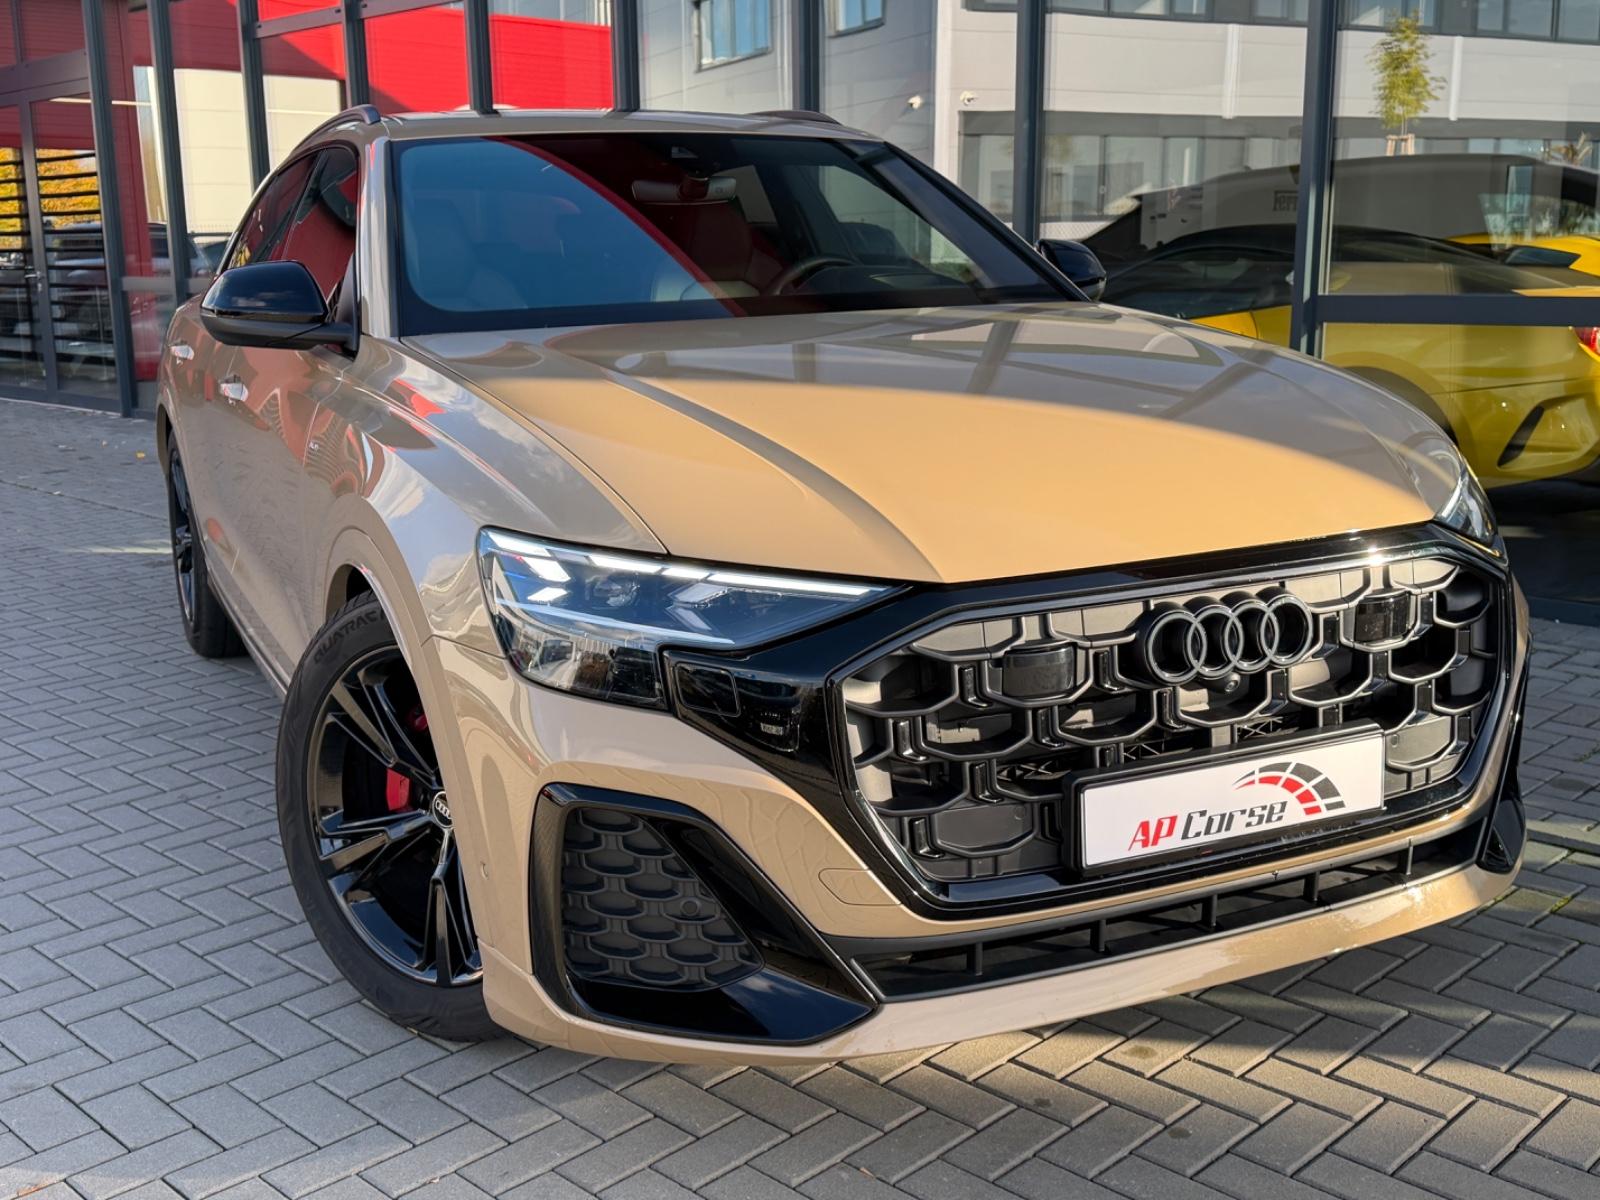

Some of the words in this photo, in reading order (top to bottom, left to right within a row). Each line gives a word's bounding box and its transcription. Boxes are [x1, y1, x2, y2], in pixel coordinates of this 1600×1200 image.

[313, 610, 377, 664] QUATRAC
[1128, 815, 1178, 850] AP
[1181, 801, 1288, 840] Corse
